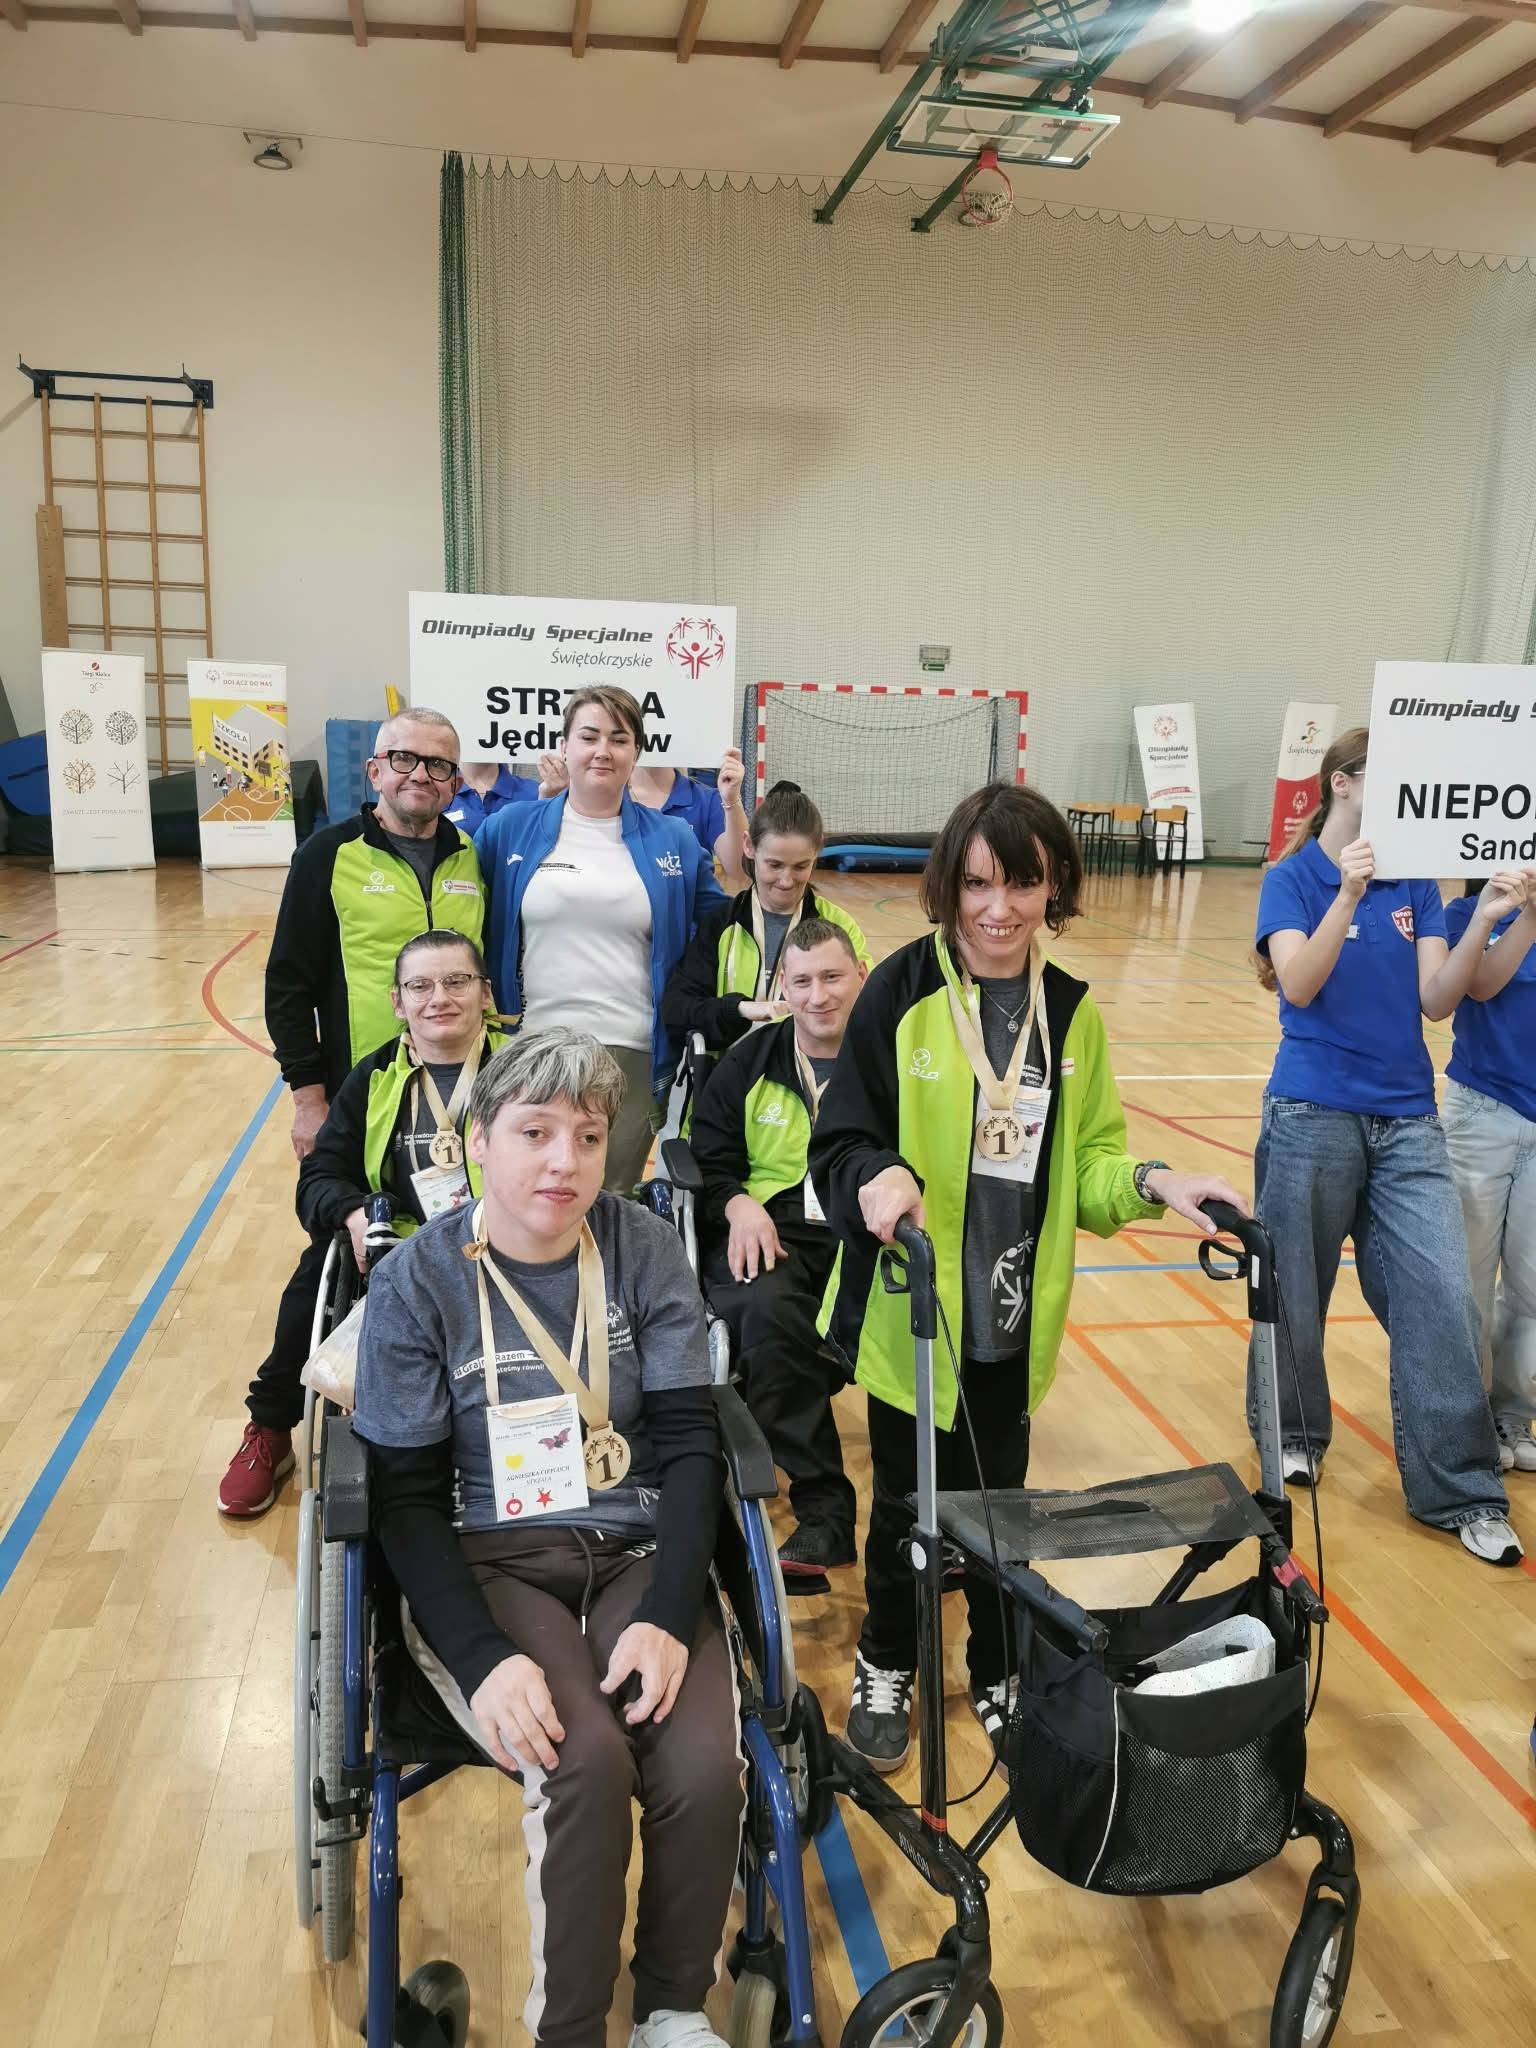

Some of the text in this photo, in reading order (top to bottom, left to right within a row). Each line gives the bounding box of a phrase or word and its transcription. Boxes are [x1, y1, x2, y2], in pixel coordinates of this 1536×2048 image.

[421, 619, 653, 644] Olimpiady Specjalne
[550, 647, 653, 669] Świętokrzyskie
[486, 686, 666, 719] STRA
[1389, 697, 1521, 723] Olimpiady
[215, 719, 249, 745] SZKOŁA
[1397, 783, 1536, 820] NIEPO
[442, 1145, 457, 1164] 1
[993, 1130, 1011, 1155] 1
[596, 1452, 617, 1484] 1
